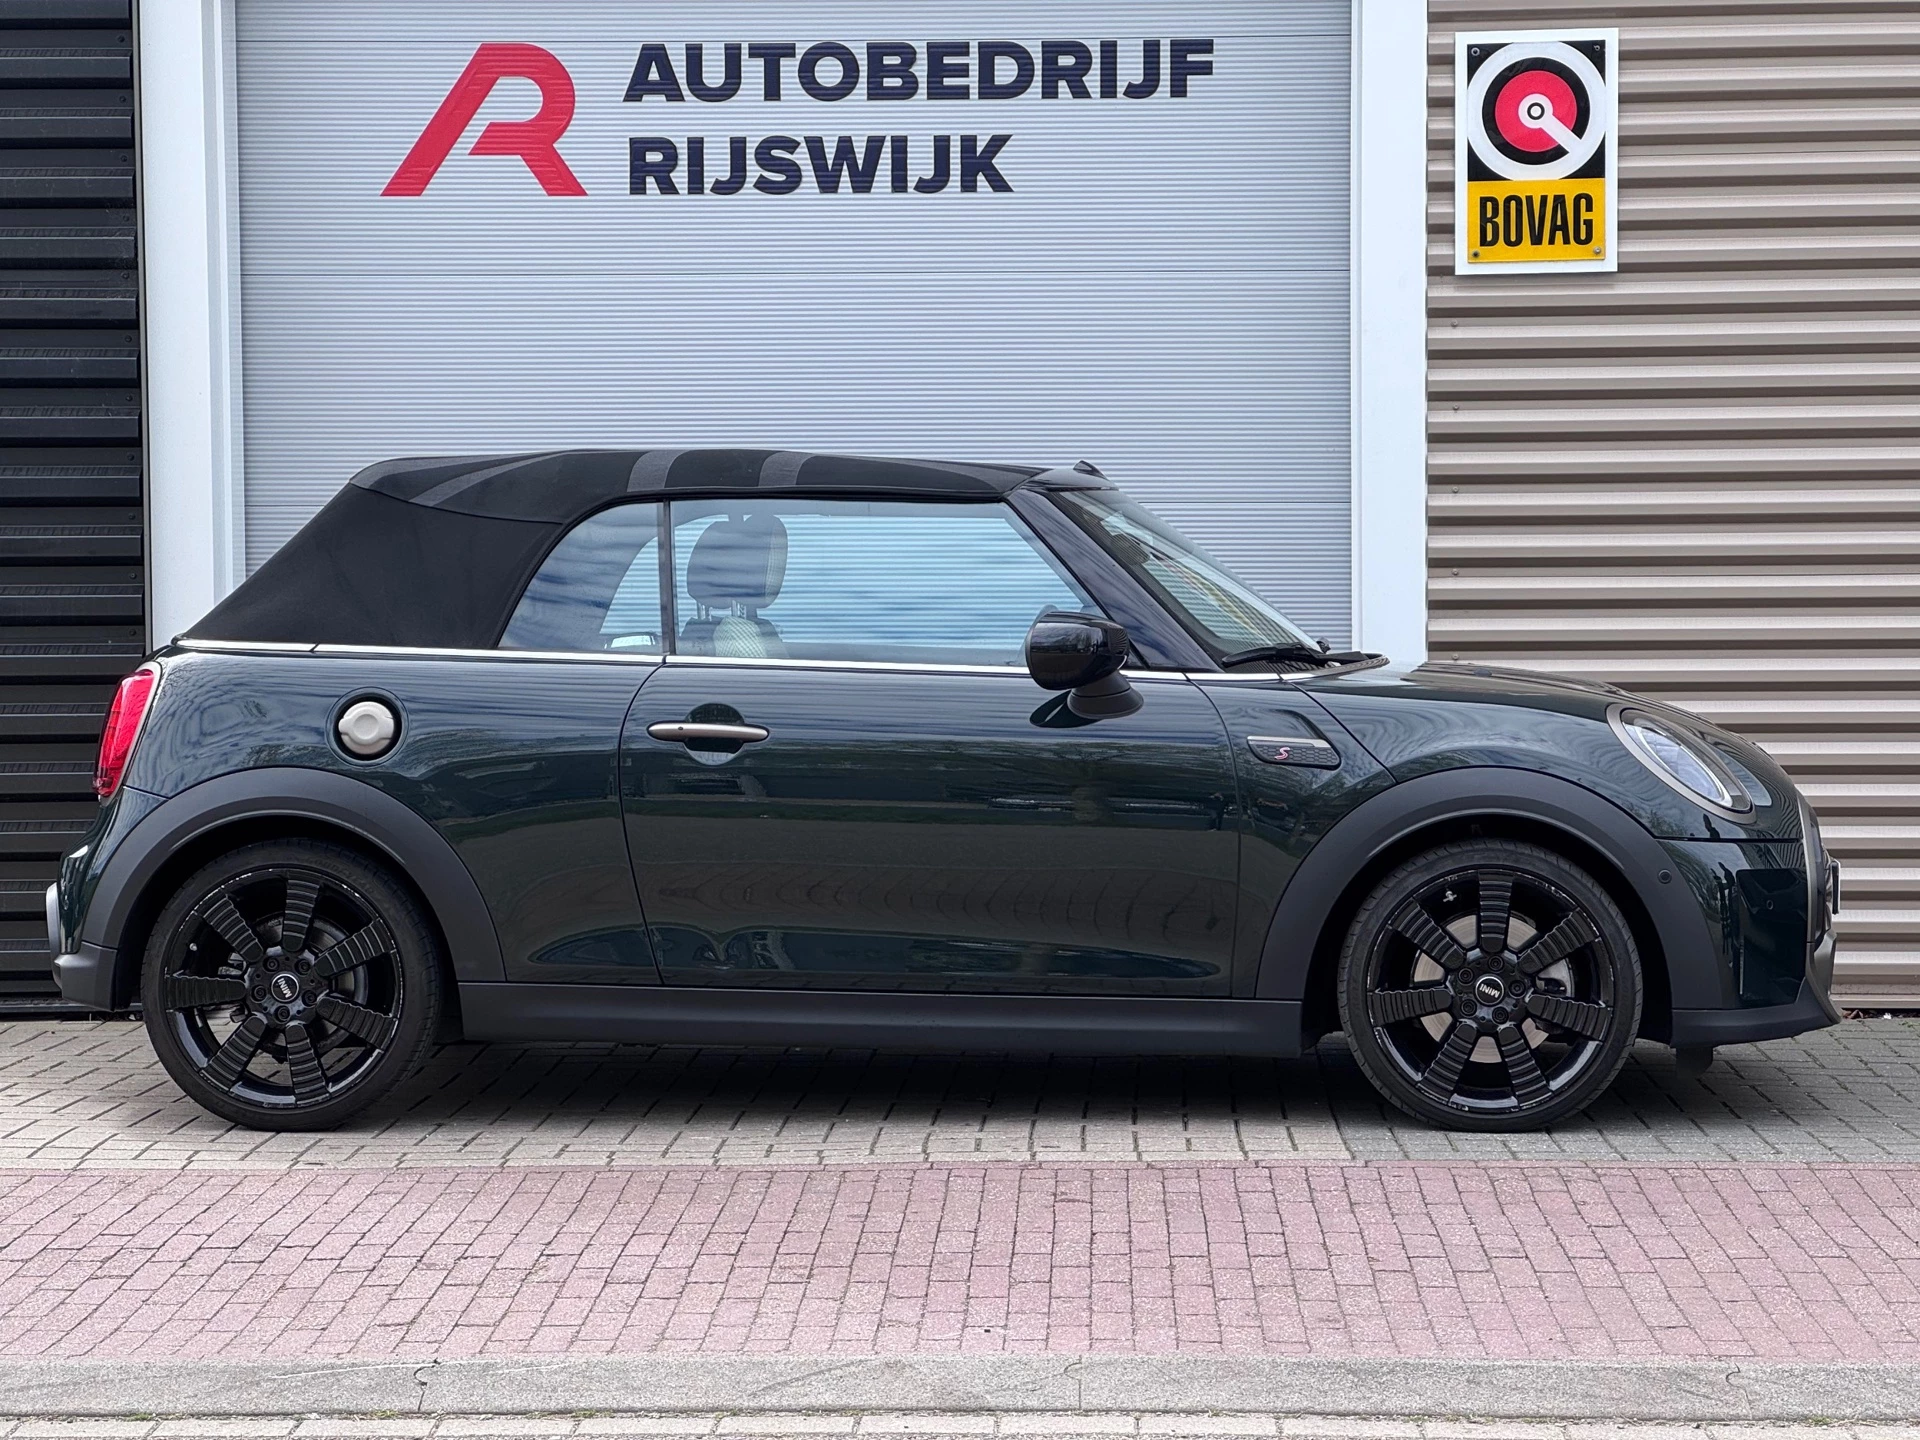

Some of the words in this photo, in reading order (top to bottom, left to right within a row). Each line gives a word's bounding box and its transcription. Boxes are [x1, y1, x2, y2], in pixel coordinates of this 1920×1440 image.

[622, 39, 1214, 102] AUTOBEDRIJF
[628, 134, 1014, 195] RIJSWIJK
[1479, 193, 1594, 247] BOVAG
[1273, 746, 1291, 760] S
[277, 977, 293, 999] MINI
[1479, 983, 1501, 999] MINI
